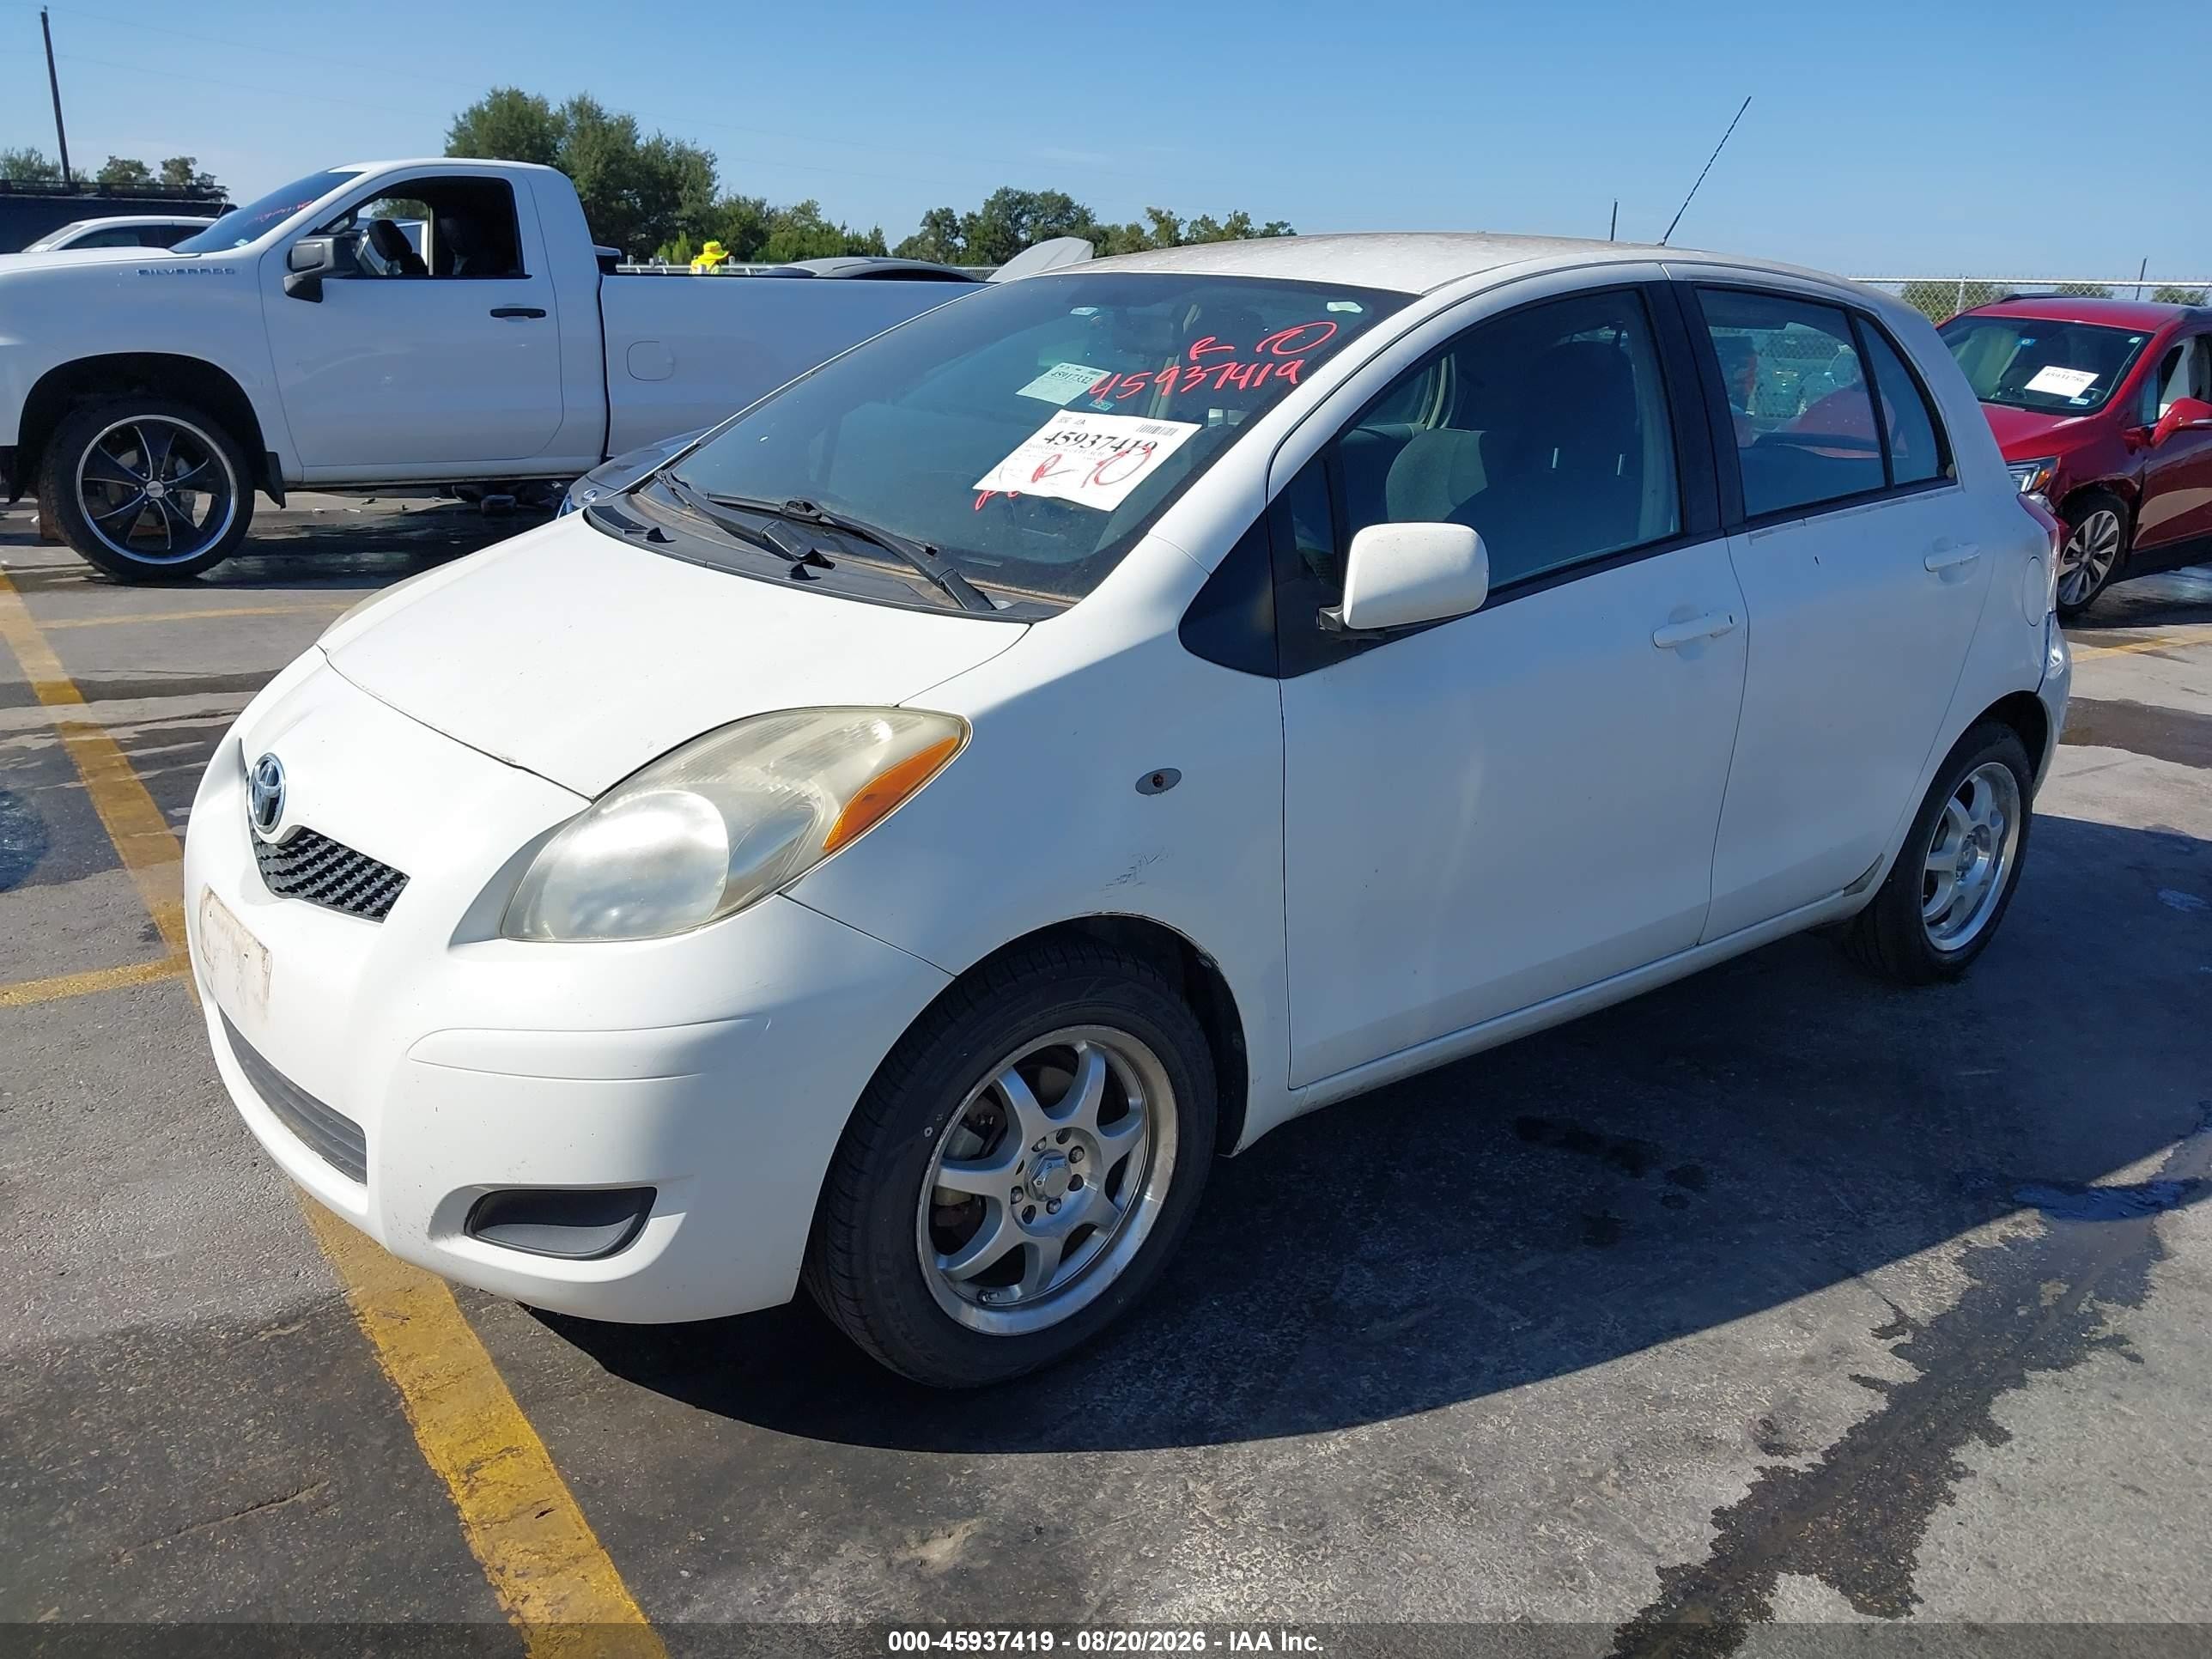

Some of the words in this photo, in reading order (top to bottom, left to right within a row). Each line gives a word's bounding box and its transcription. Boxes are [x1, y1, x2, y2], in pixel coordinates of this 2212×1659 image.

[137, 267, 235, 276] SILVERADO
[1089, 359, 1305, 403] 45937419
[1044, 430, 1158, 458] 45937419
